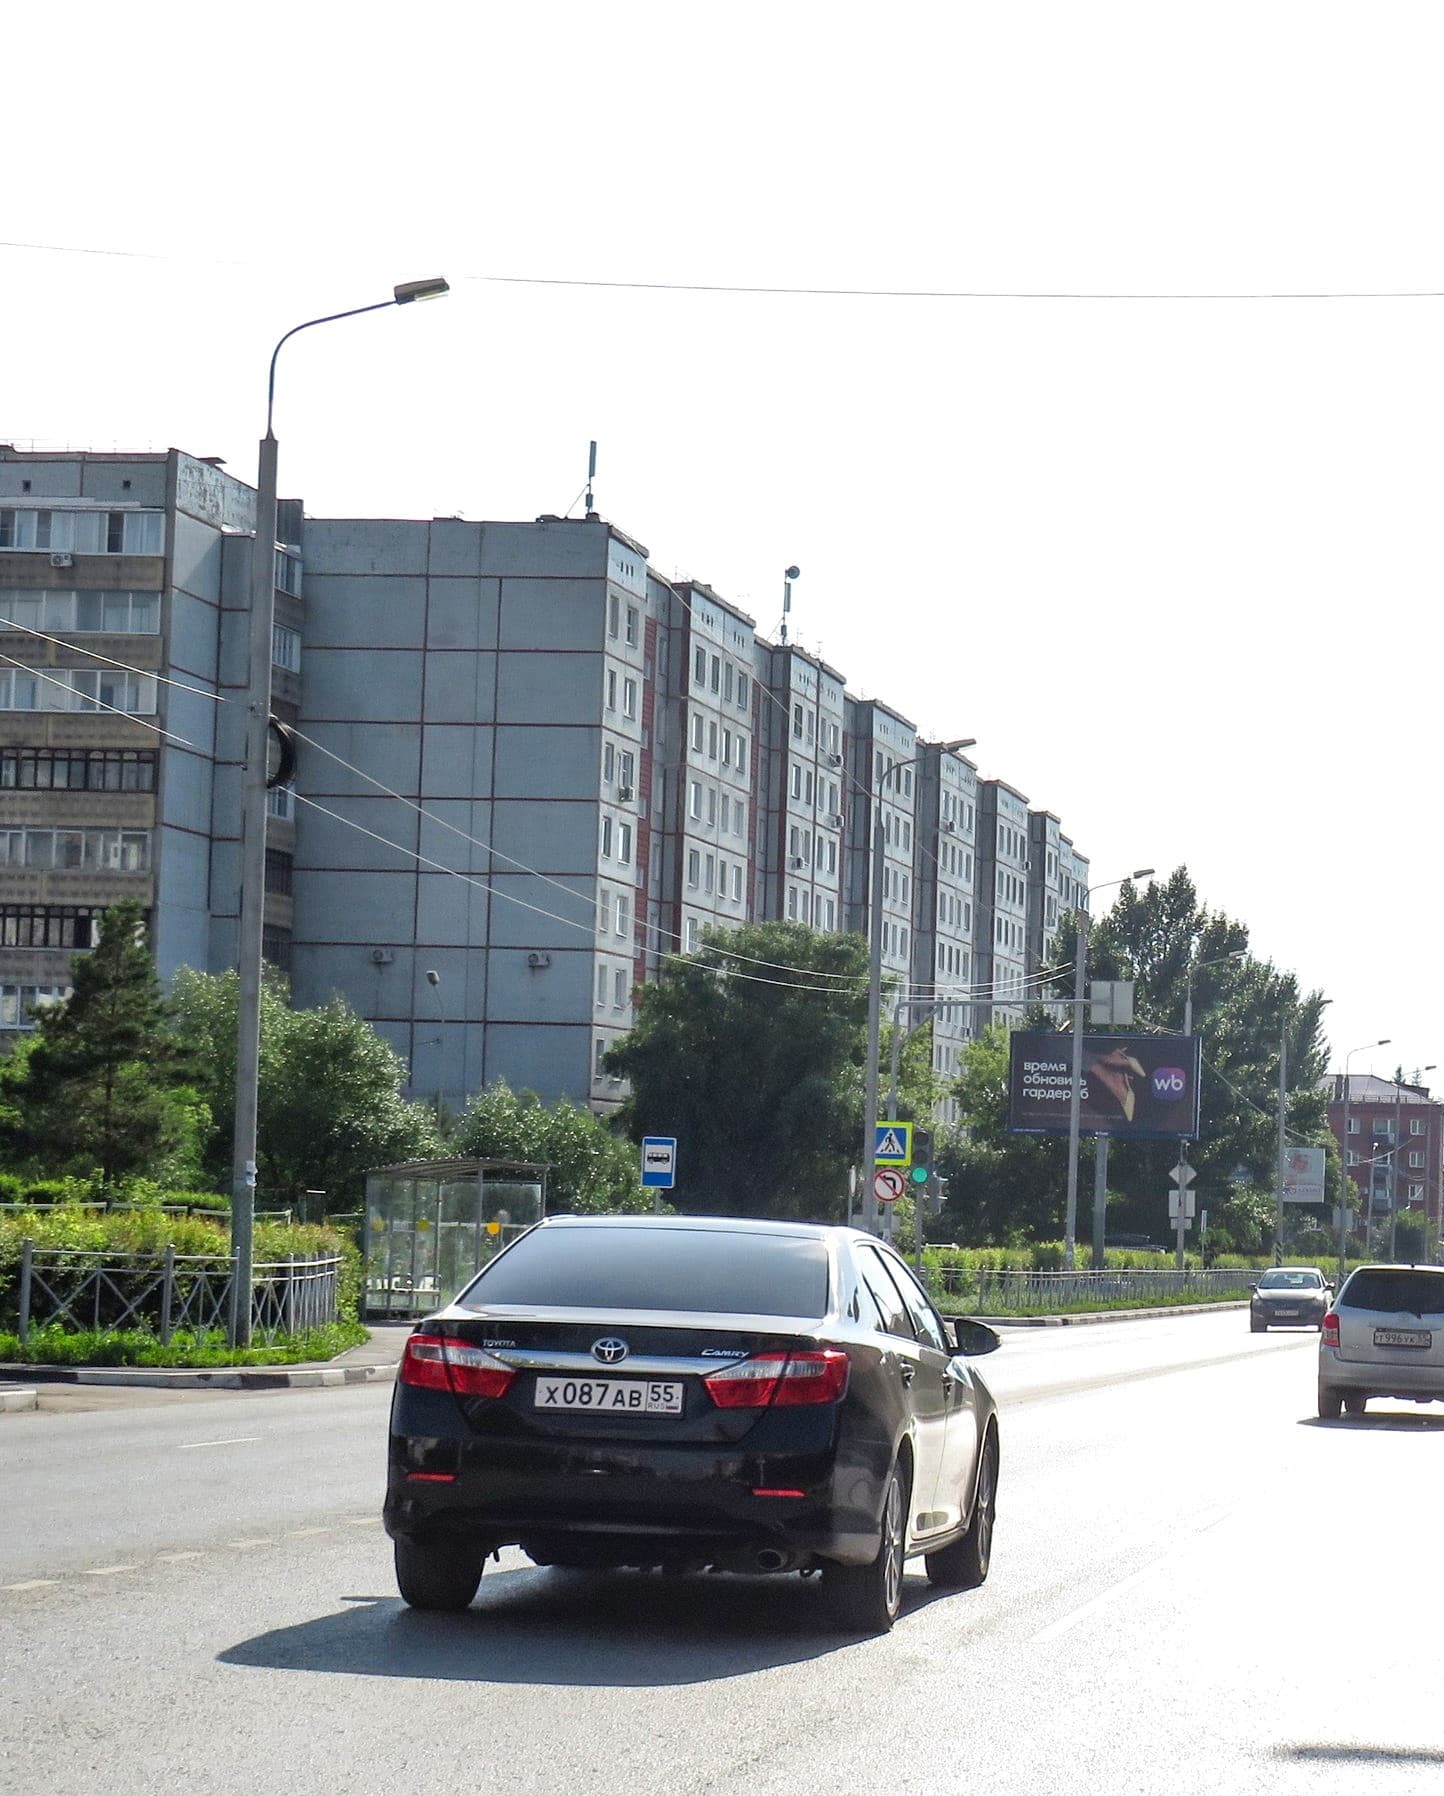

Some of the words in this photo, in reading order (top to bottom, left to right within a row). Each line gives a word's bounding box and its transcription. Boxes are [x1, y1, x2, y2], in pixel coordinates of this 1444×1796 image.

[1023, 1061, 1067, 1072] время
[1023, 1073, 1087, 1086] обновиь
[1154, 1074, 1184, 1092] wb
[1022, 1086, 1090, 1101] гардерб
[482, 1339, 517, 1348] TOYOTA
[650, 1384, 675, 1403] 55
